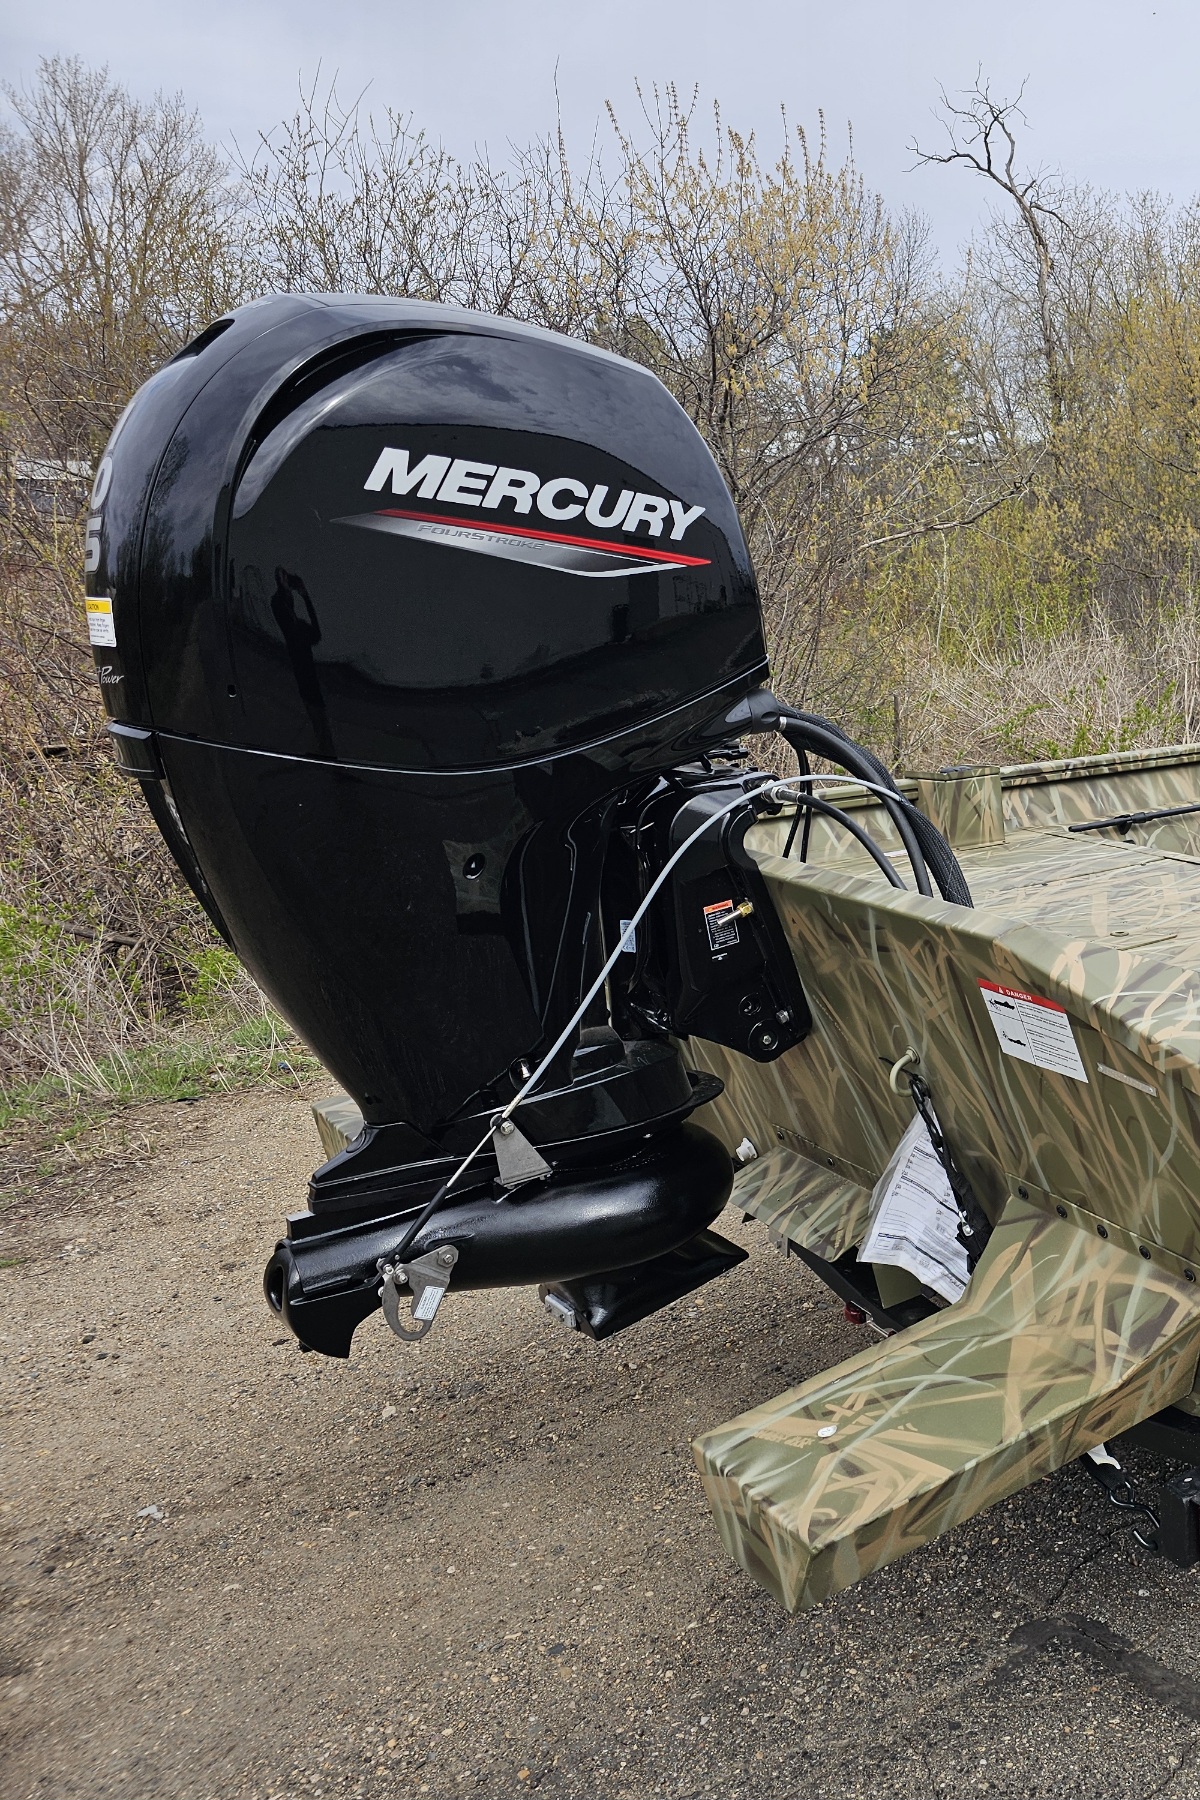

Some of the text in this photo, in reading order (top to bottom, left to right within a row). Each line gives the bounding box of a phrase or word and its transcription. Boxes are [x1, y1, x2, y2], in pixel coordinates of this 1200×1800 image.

[363, 446, 706, 541] MERCURY
[417, 523, 545, 551] FOURSTROKE
[1005, 989, 1033, 1002] DANGER
